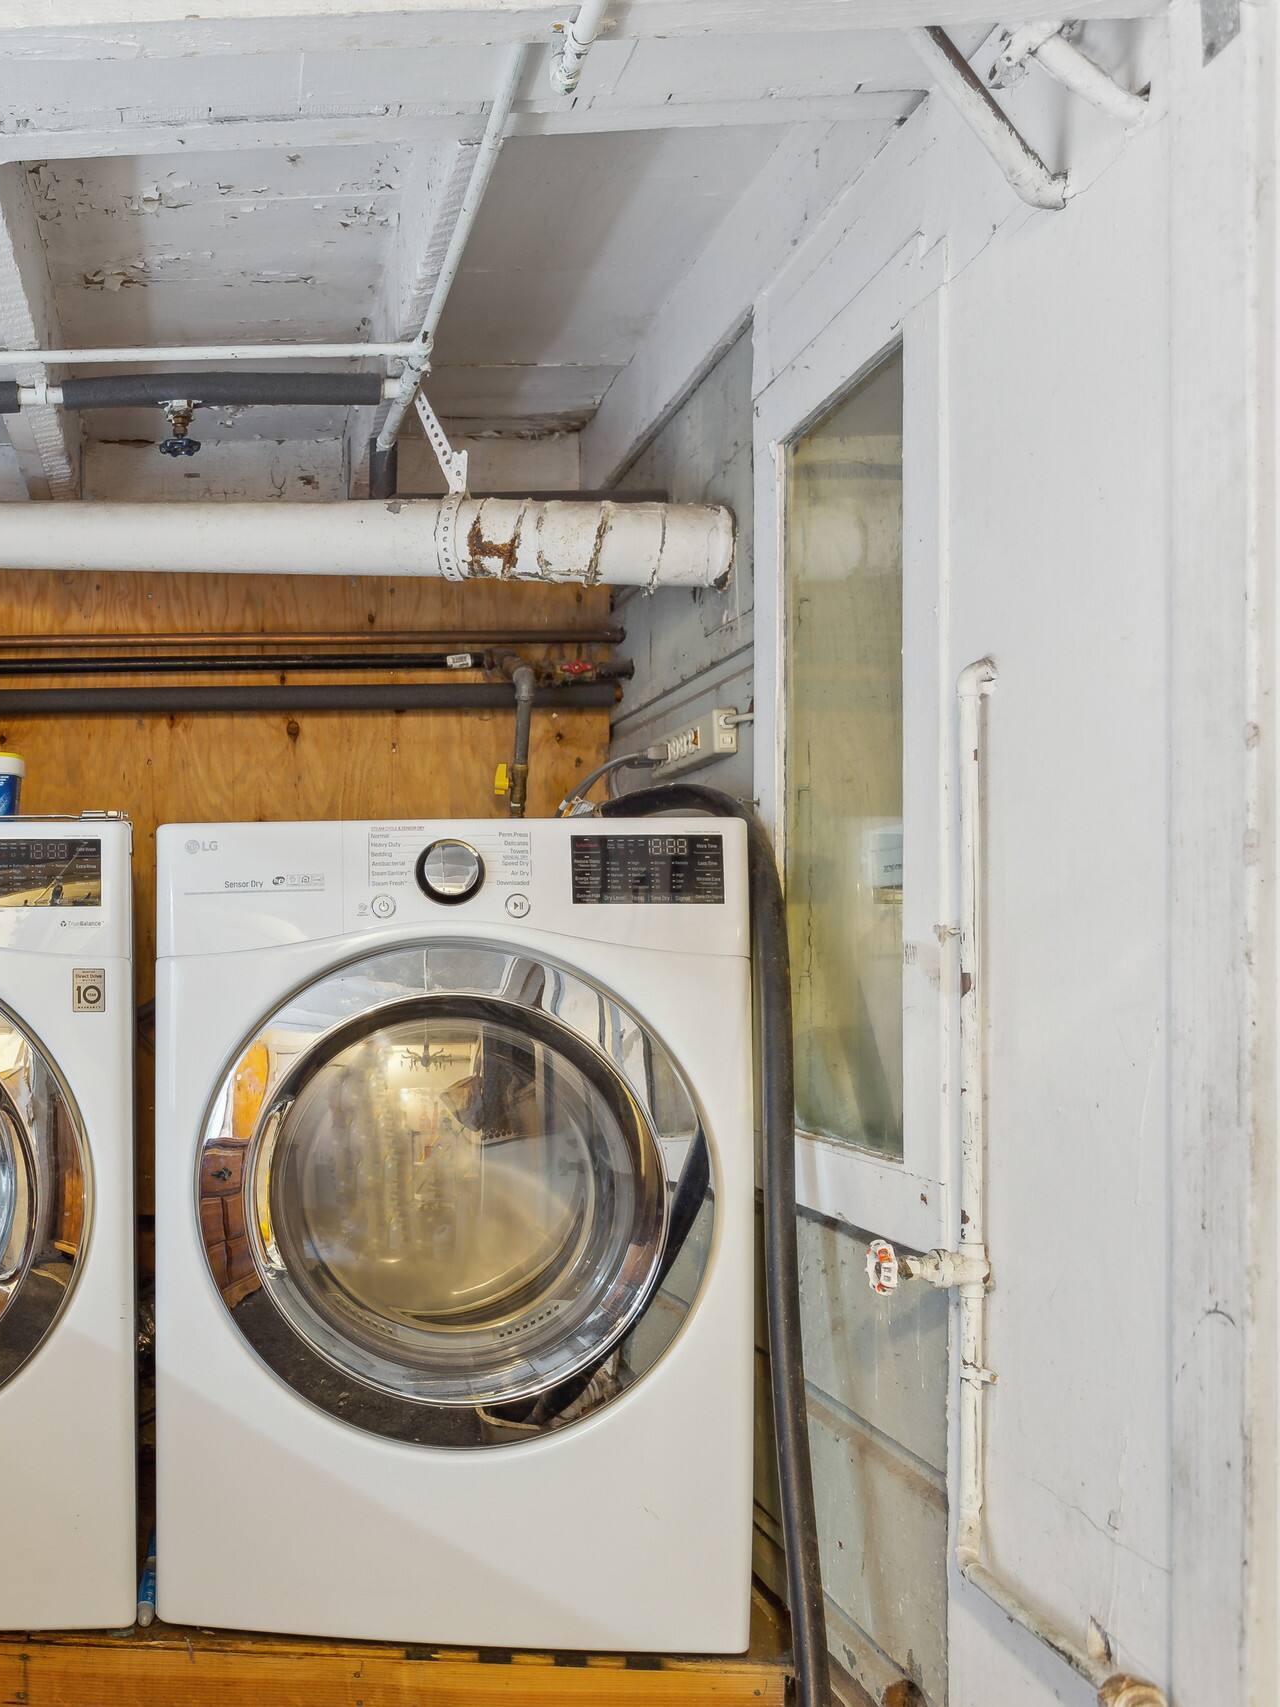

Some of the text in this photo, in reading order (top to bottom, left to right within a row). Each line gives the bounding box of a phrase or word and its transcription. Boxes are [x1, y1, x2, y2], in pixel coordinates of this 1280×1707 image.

[201, 840, 218, 851] LG
[224, 880, 264, 888] Sensor Dry
[76, 985, 101, 1004] 10
